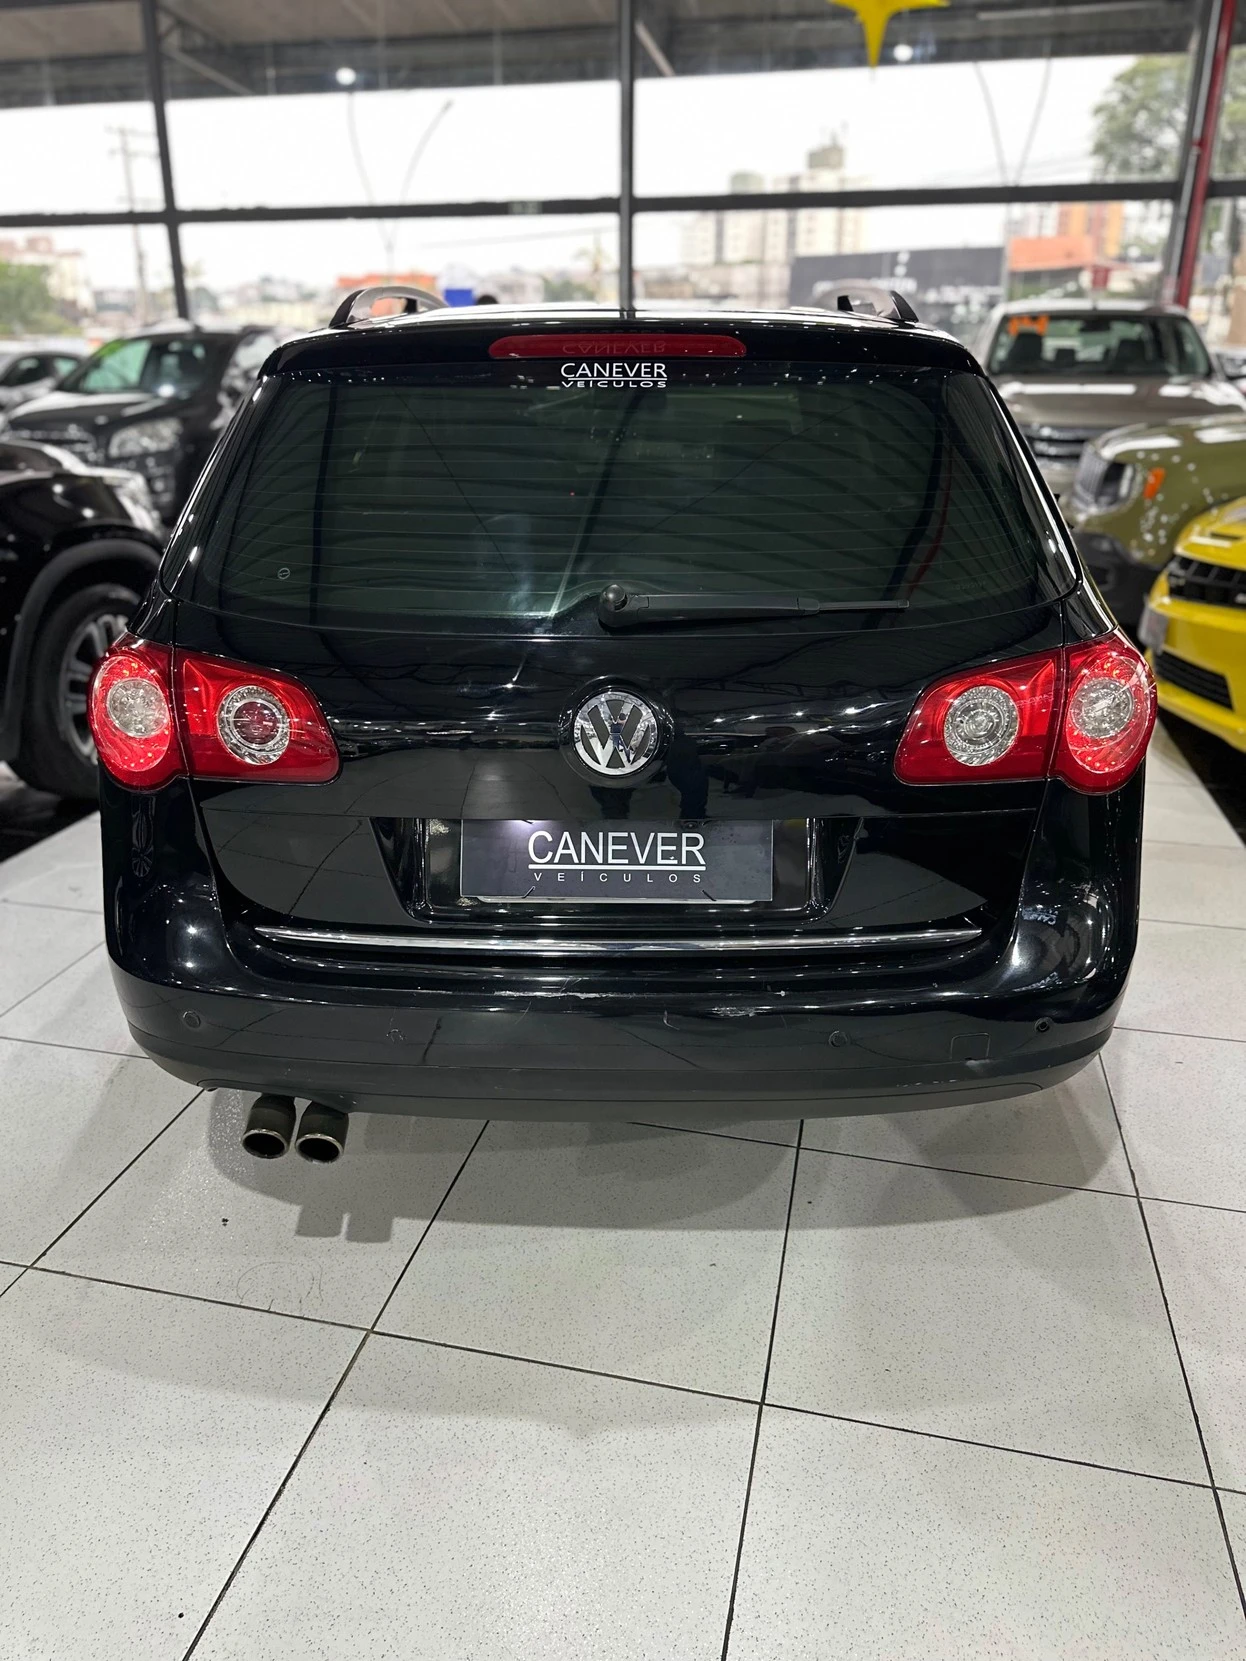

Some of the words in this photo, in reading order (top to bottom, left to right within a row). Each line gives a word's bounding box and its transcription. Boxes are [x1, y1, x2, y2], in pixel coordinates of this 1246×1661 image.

[561, 362, 667, 378] CANEVER
[528, 830, 706, 865] CANEVER
[533, 871, 702, 884] VEÍCULOS
